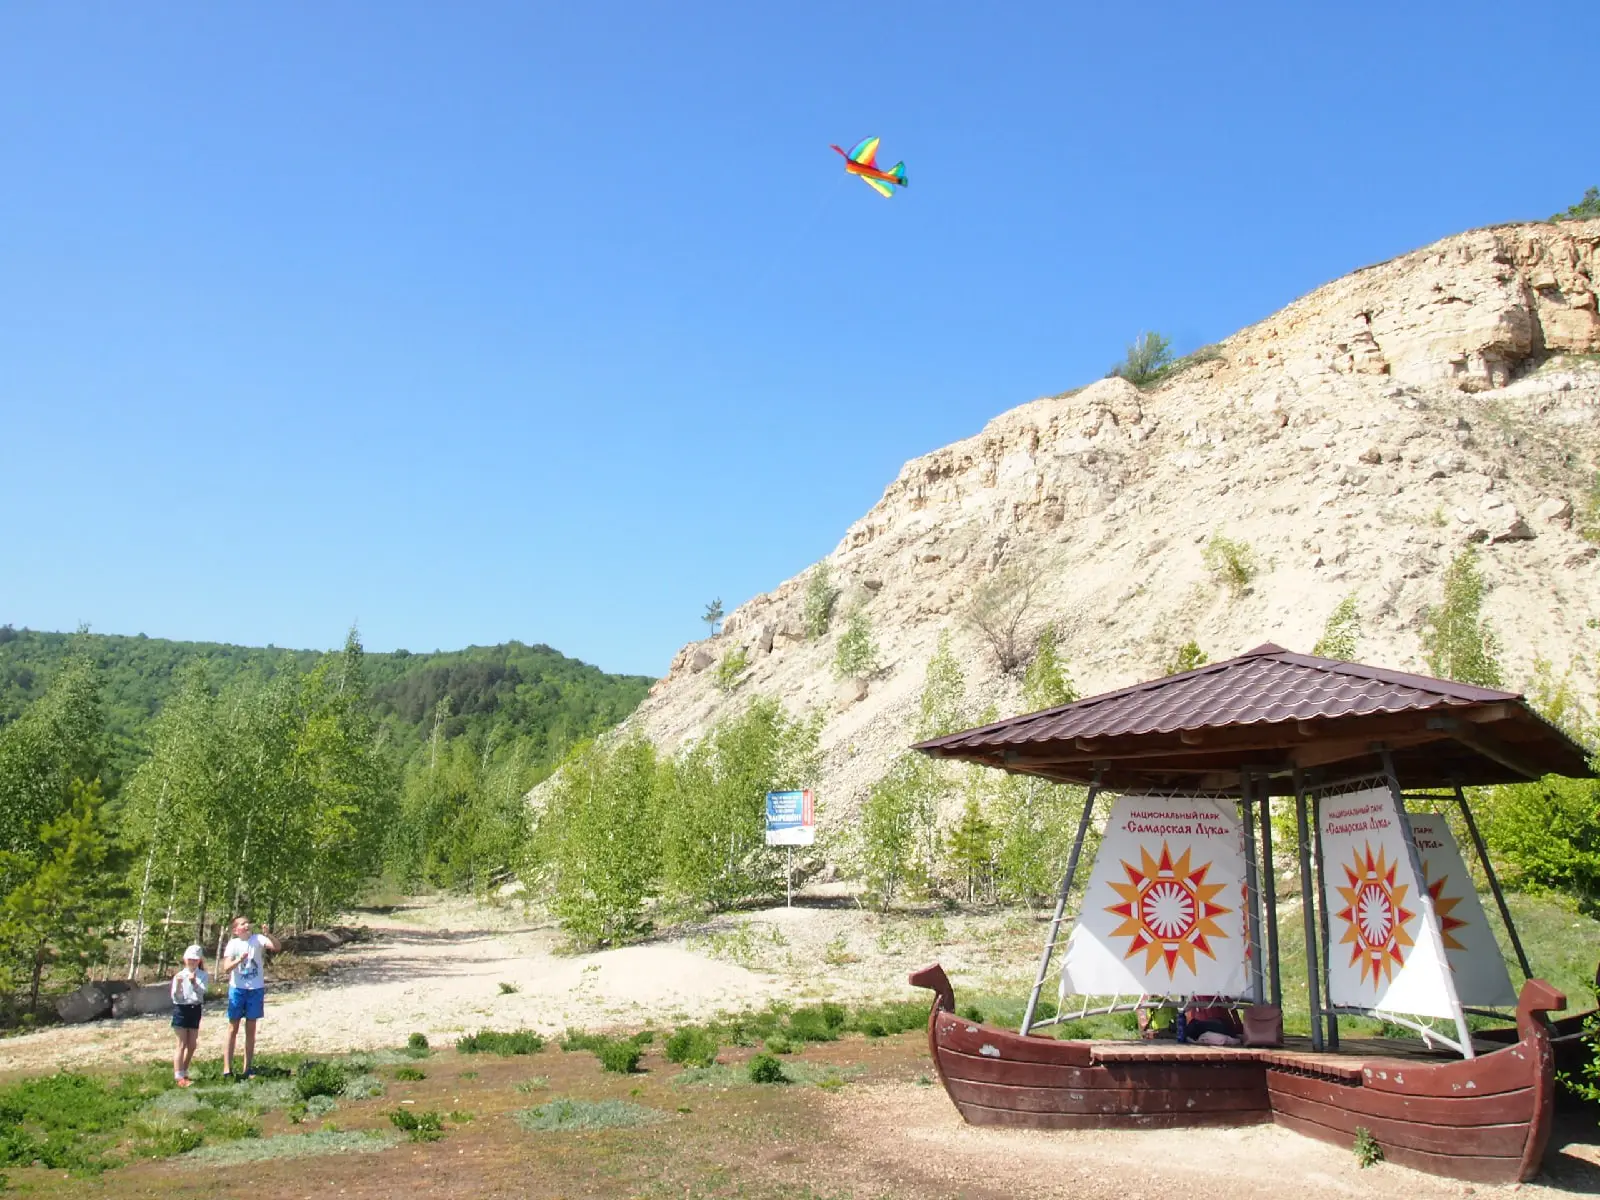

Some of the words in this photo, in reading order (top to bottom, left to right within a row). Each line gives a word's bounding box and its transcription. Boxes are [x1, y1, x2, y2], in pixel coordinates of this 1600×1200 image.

[1130, 810, 1198, 820] НАЦИОНАЛЬНЫЙ
[1199, 812, 1220, 820] ПАРК
[1121, 820, 1192, 836] «Самарская
[1195, 822, 1230, 838] Лука»
